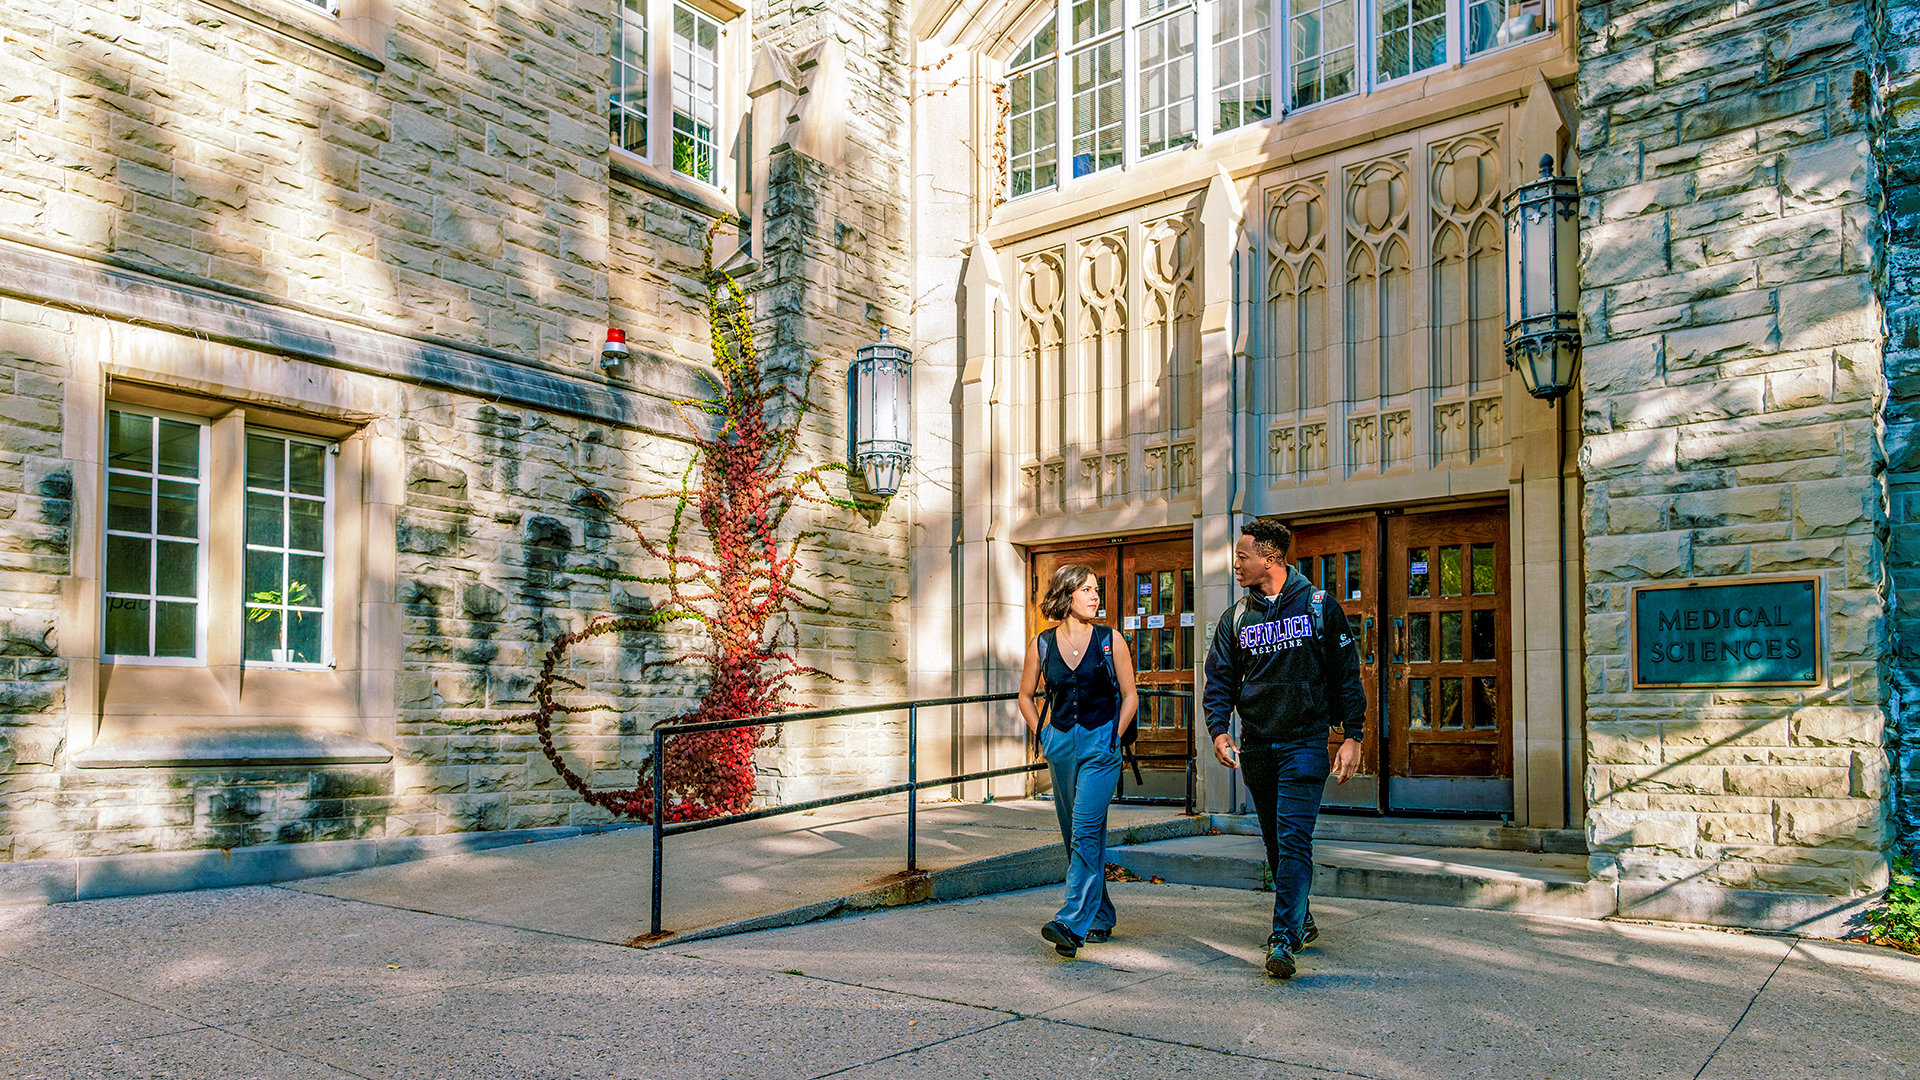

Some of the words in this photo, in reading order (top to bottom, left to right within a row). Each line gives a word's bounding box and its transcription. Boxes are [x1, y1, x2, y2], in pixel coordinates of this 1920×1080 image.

[1658, 605, 1791, 631] MEDICAL
[1240, 614, 1312, 649] SCHULICH
[1250, 639, 1303, 656] MEDICINE
[1650, 637, 1801, 663] SCIENCES
